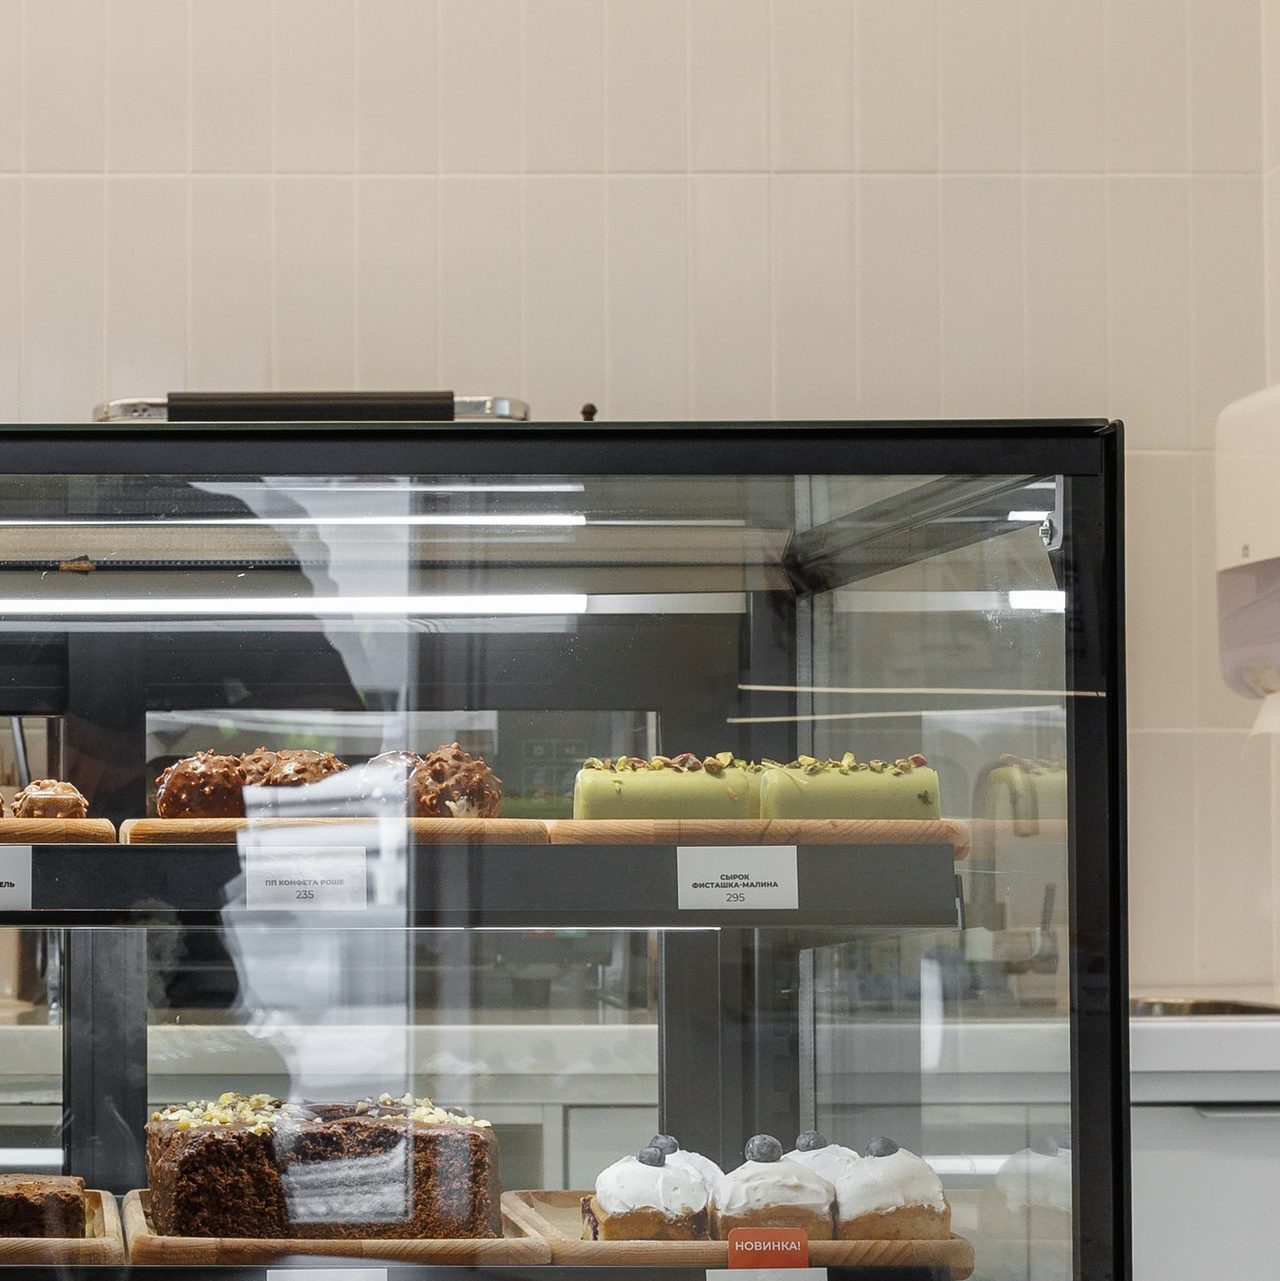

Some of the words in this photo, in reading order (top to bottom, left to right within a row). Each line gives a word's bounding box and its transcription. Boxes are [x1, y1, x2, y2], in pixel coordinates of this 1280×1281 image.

[719, 873, 750, 881] СЫРОК
[265, 879, 278, 887] ПП
[691, 880, 779, 889] ФИСТАШКА-МАЛИНА
[295, 889, 315, 900] 235
[725, 892, 746, 903] 295
[734, 1240, 802, 1252] НОВИНКА!
